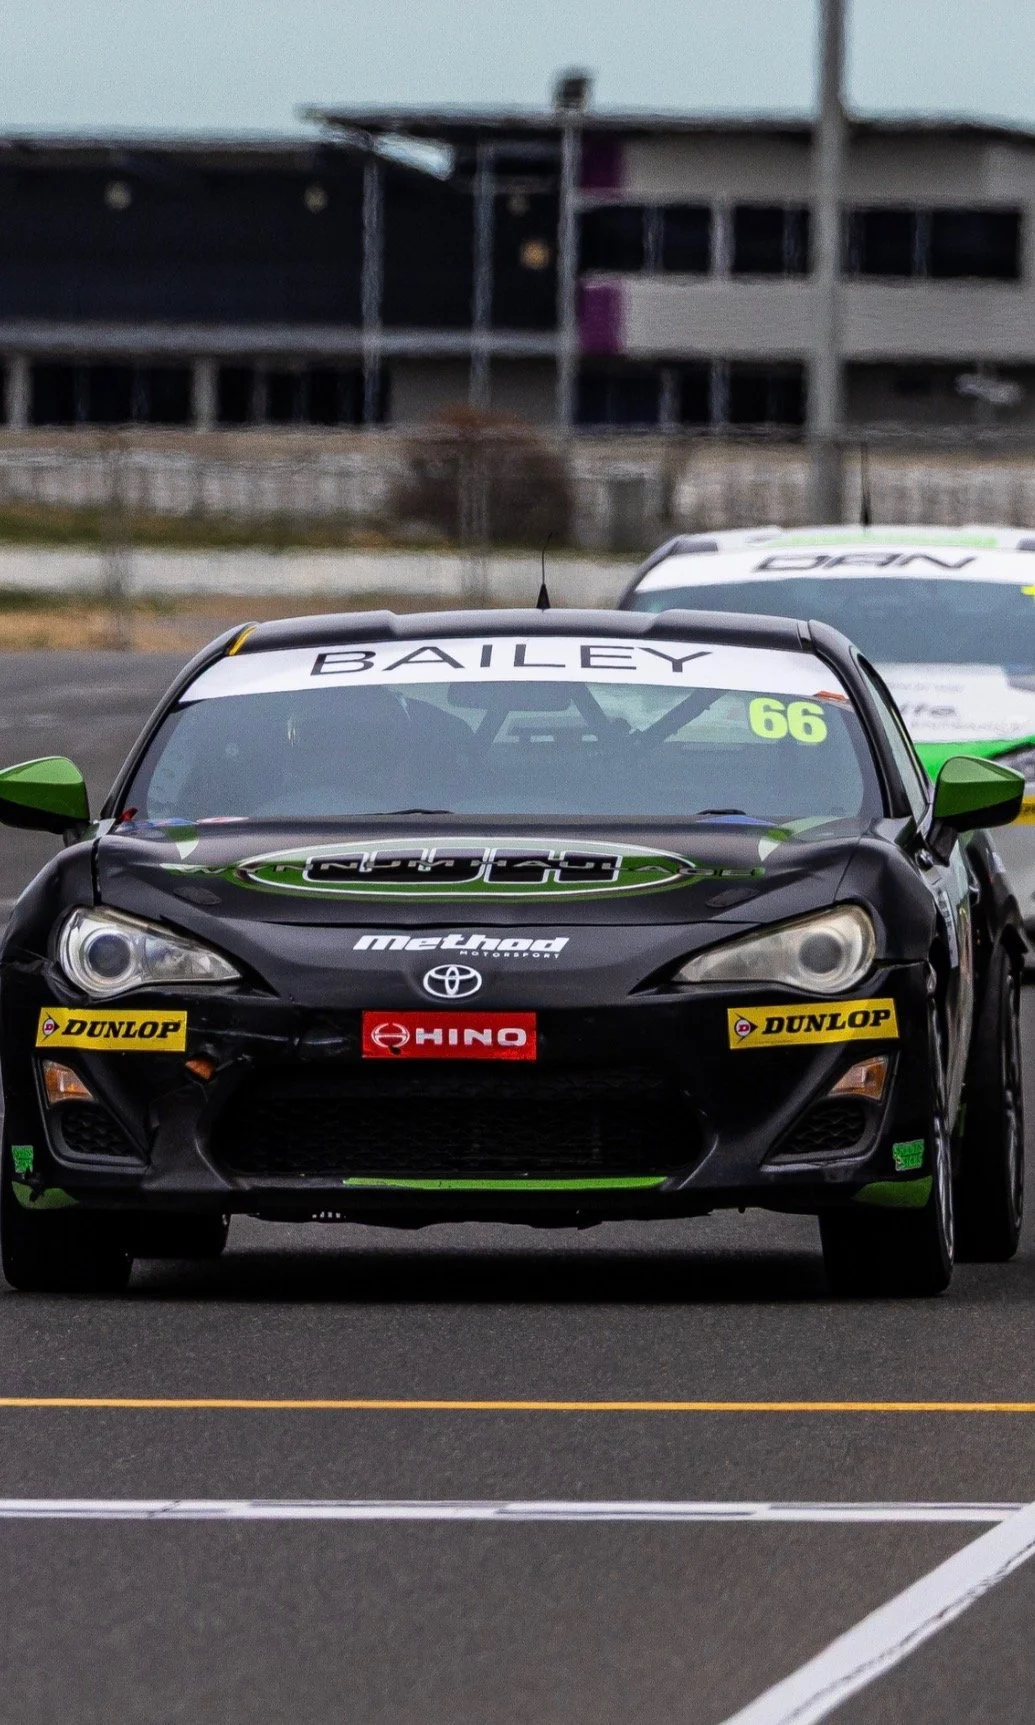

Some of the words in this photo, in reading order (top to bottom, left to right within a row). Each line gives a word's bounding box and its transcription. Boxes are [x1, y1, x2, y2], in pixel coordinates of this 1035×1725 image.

[752, 553, 976, 571] DAN
[310, 643, 712, 676] BAILEY
[749, 697, 828, 743] 66
[460, 951, 559, 959] MOTORSPORT
[62, 1019, 181, 1039] DUNLOP
[762, 1009, 891, 1034] DUNLOP
[415, 1027, 527, 1046] HINO
